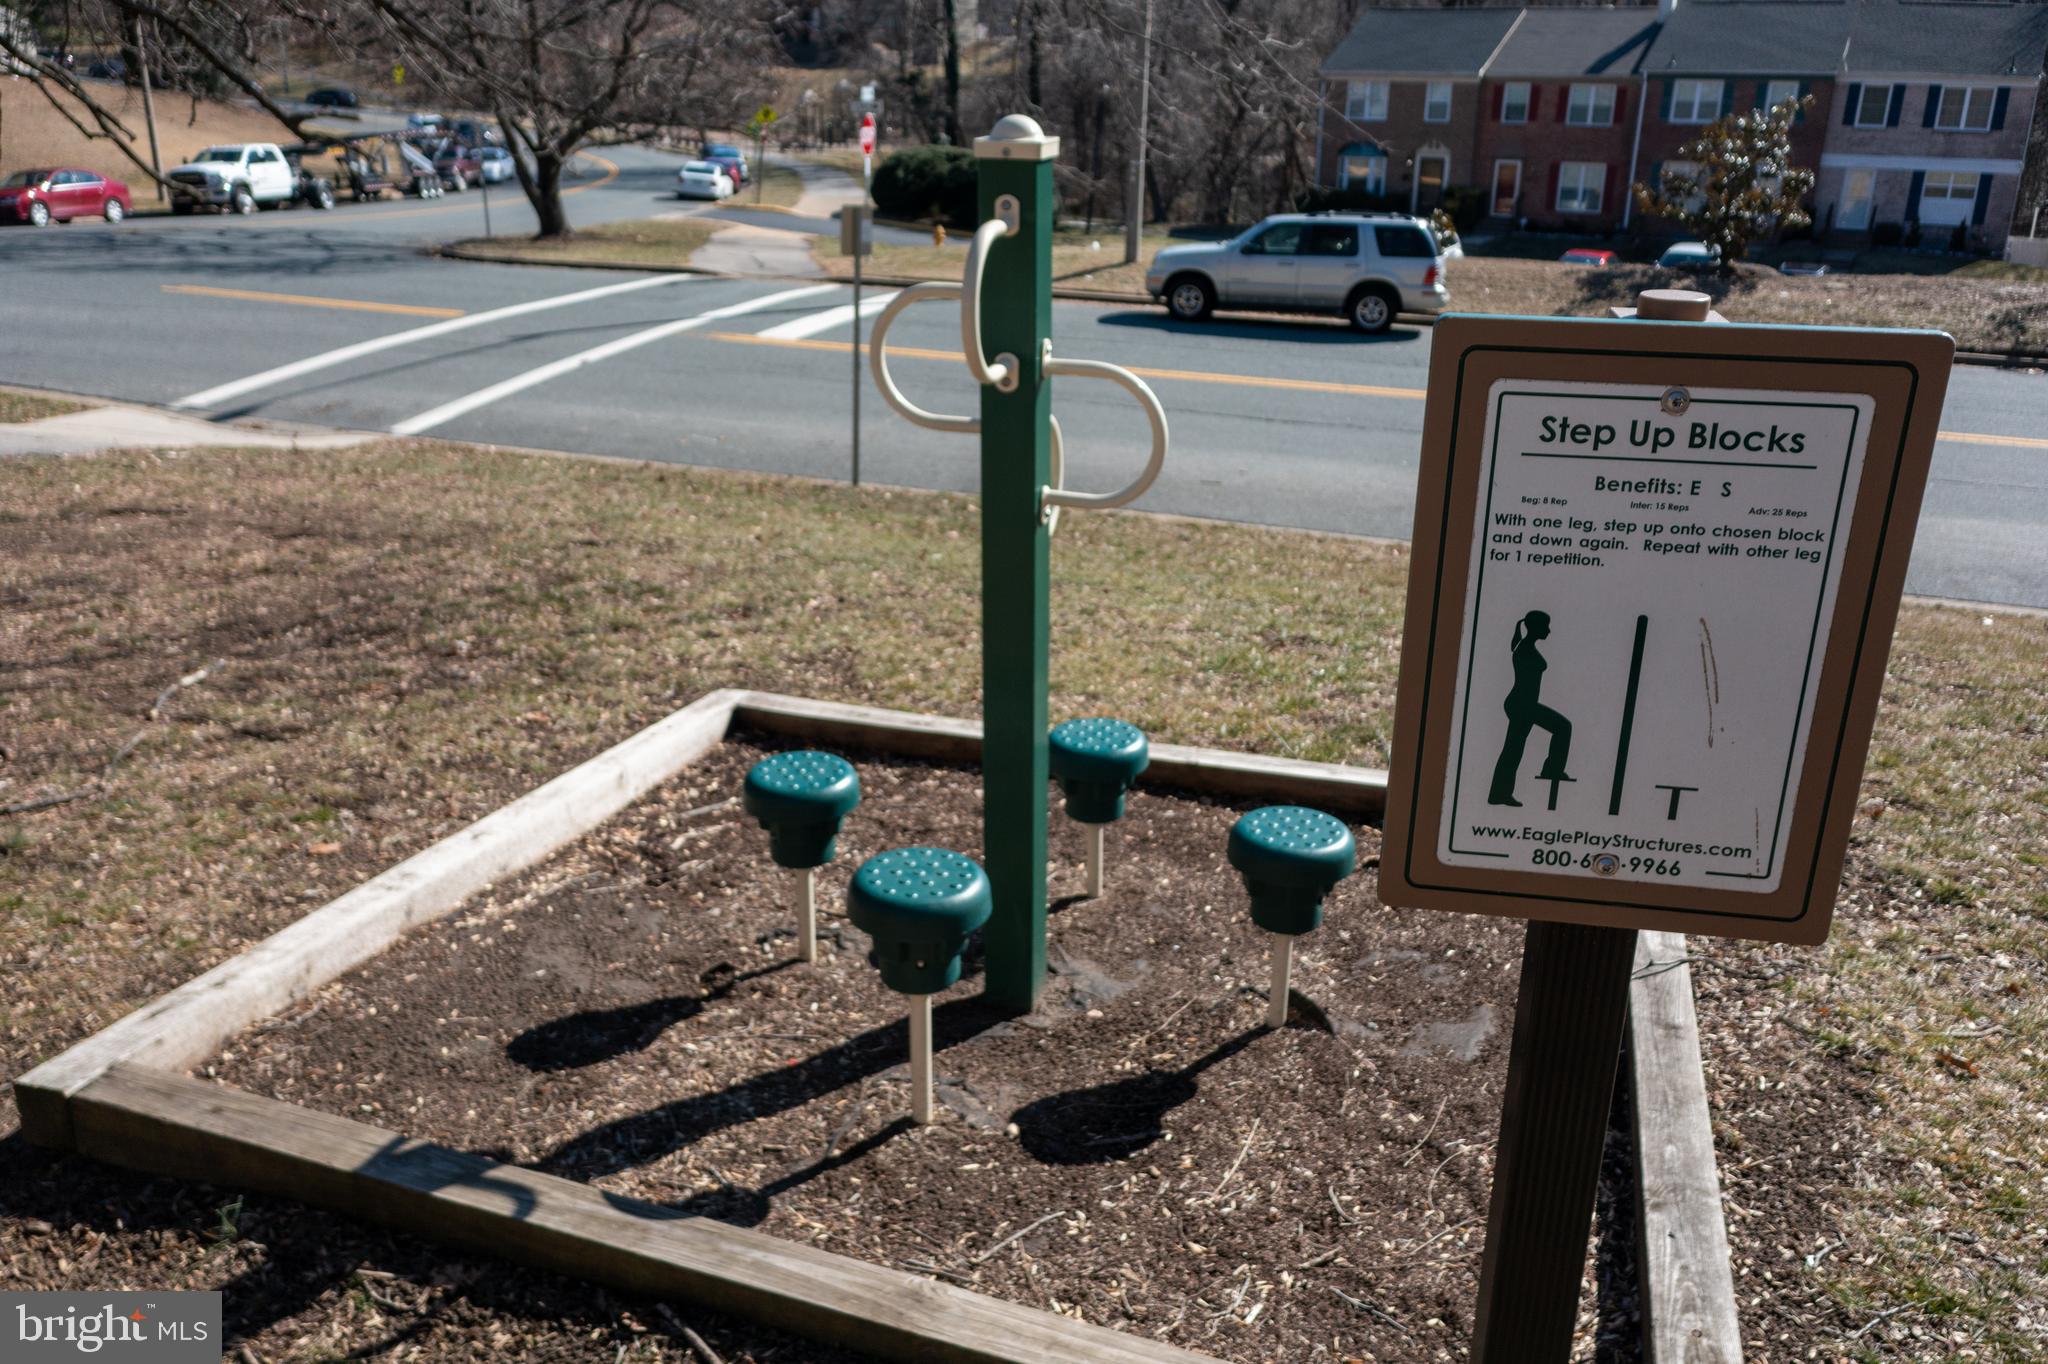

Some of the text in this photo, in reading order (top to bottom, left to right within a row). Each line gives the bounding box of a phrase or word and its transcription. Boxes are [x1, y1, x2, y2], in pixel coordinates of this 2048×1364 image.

[1538, 415, 1807, 455] Step Up Blocks
[1594, 475, 1733, 498] Benefits: E S
[1550, 496, 1568, 507] Rep
[1630, 500, 1690, 513] Inter: 15 Reps
[1748, 506, 1808, 519] Adv: 25 Reps
[1494, 512, 1826, 543] With one leg, step up onto chosen block
[1489, 547, 1605, 567] for 1 repetition.
[1491, 531, 1822, 564] and down again. Repeat with other leg
[1471, 825, 1753, 859] www.EaglePlayStructures.com
